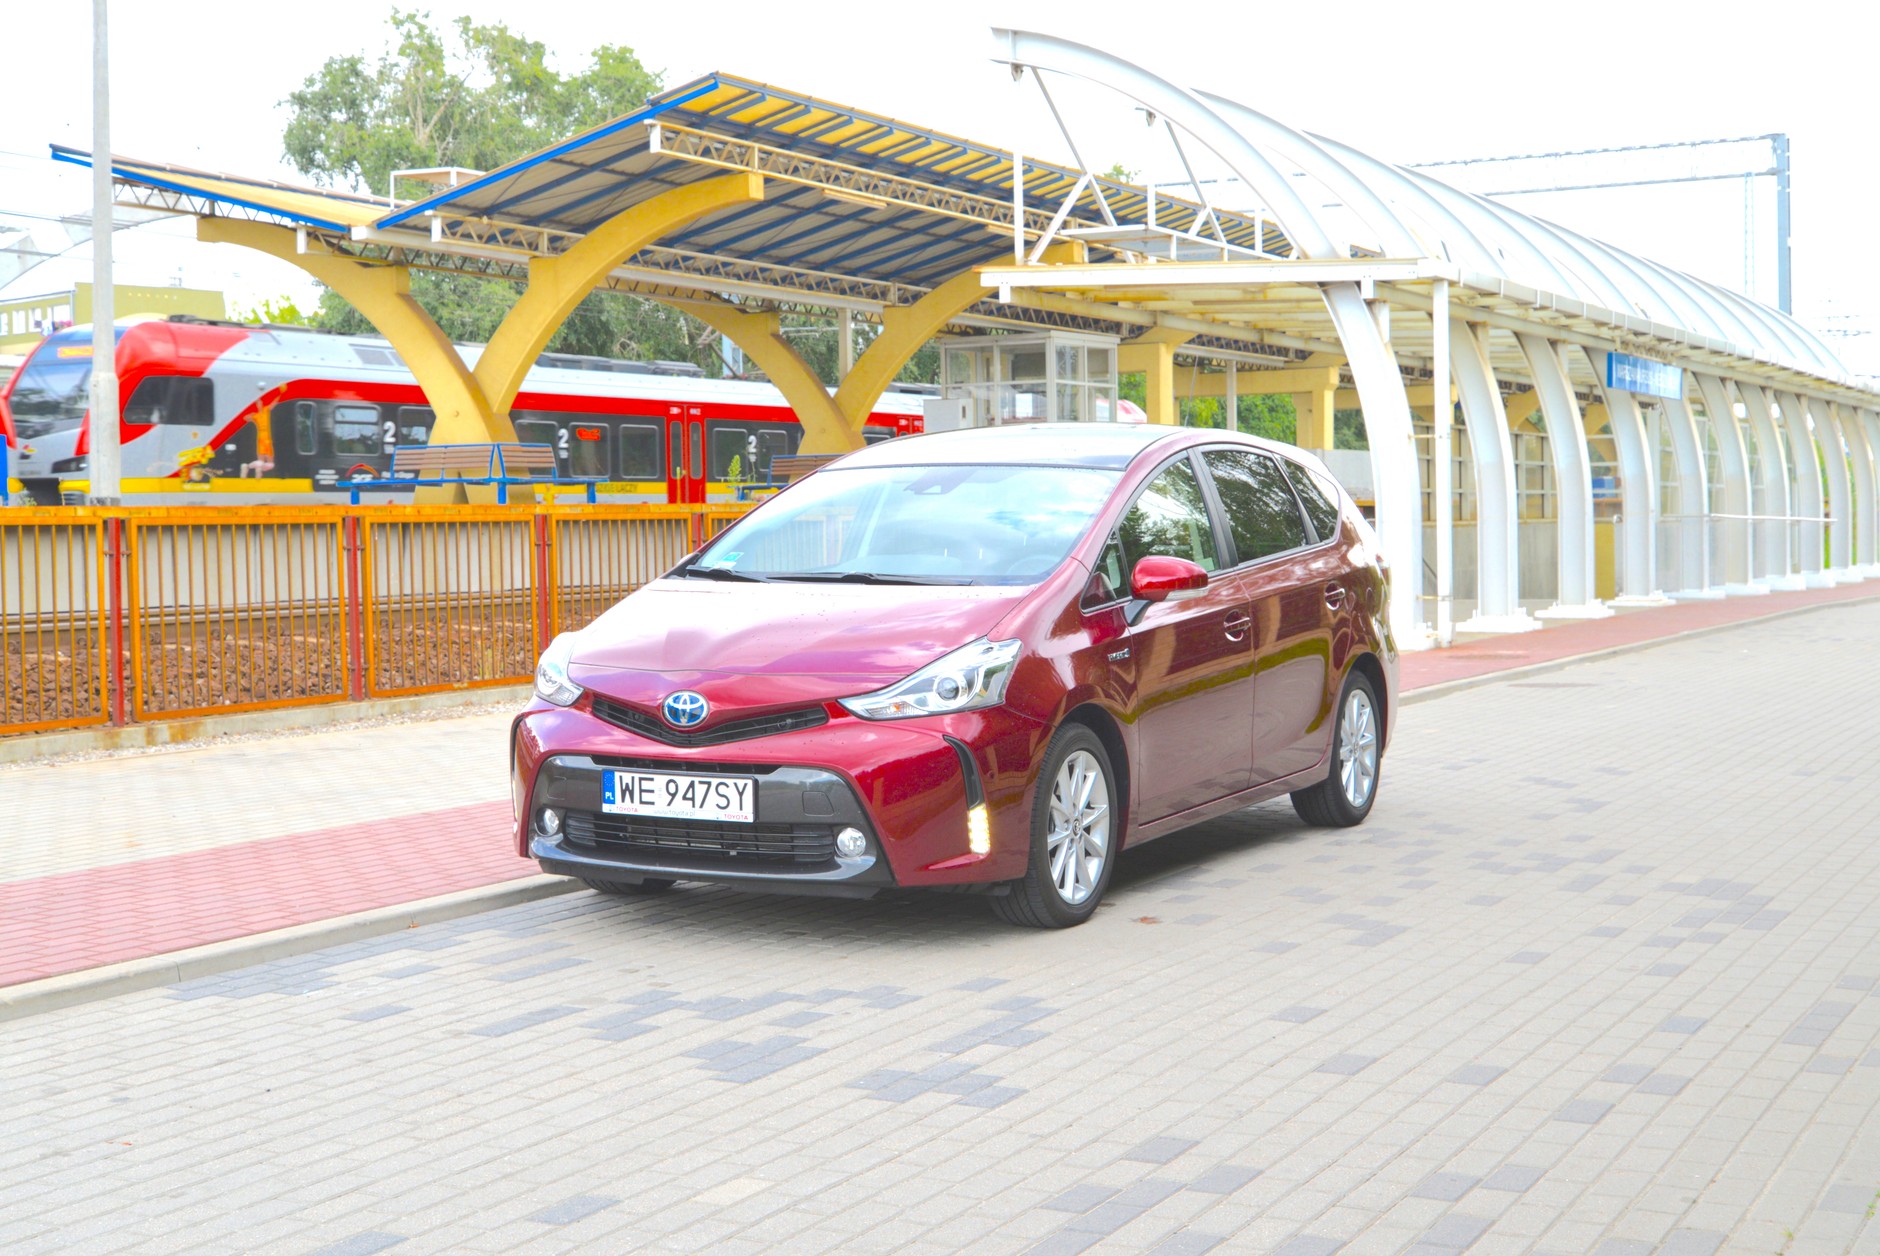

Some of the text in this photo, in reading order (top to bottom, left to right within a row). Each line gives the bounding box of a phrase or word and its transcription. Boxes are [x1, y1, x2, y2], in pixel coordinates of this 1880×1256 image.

[383, 421, 396, 443] 2
[558, 428, 569, 448] 2
[747, 435, 757, 452] 2
[605, 791, 614, 801] PL
[619, 775, 748, 811] WE 947SY
[616, 806, 639, 814] TOYOTA
